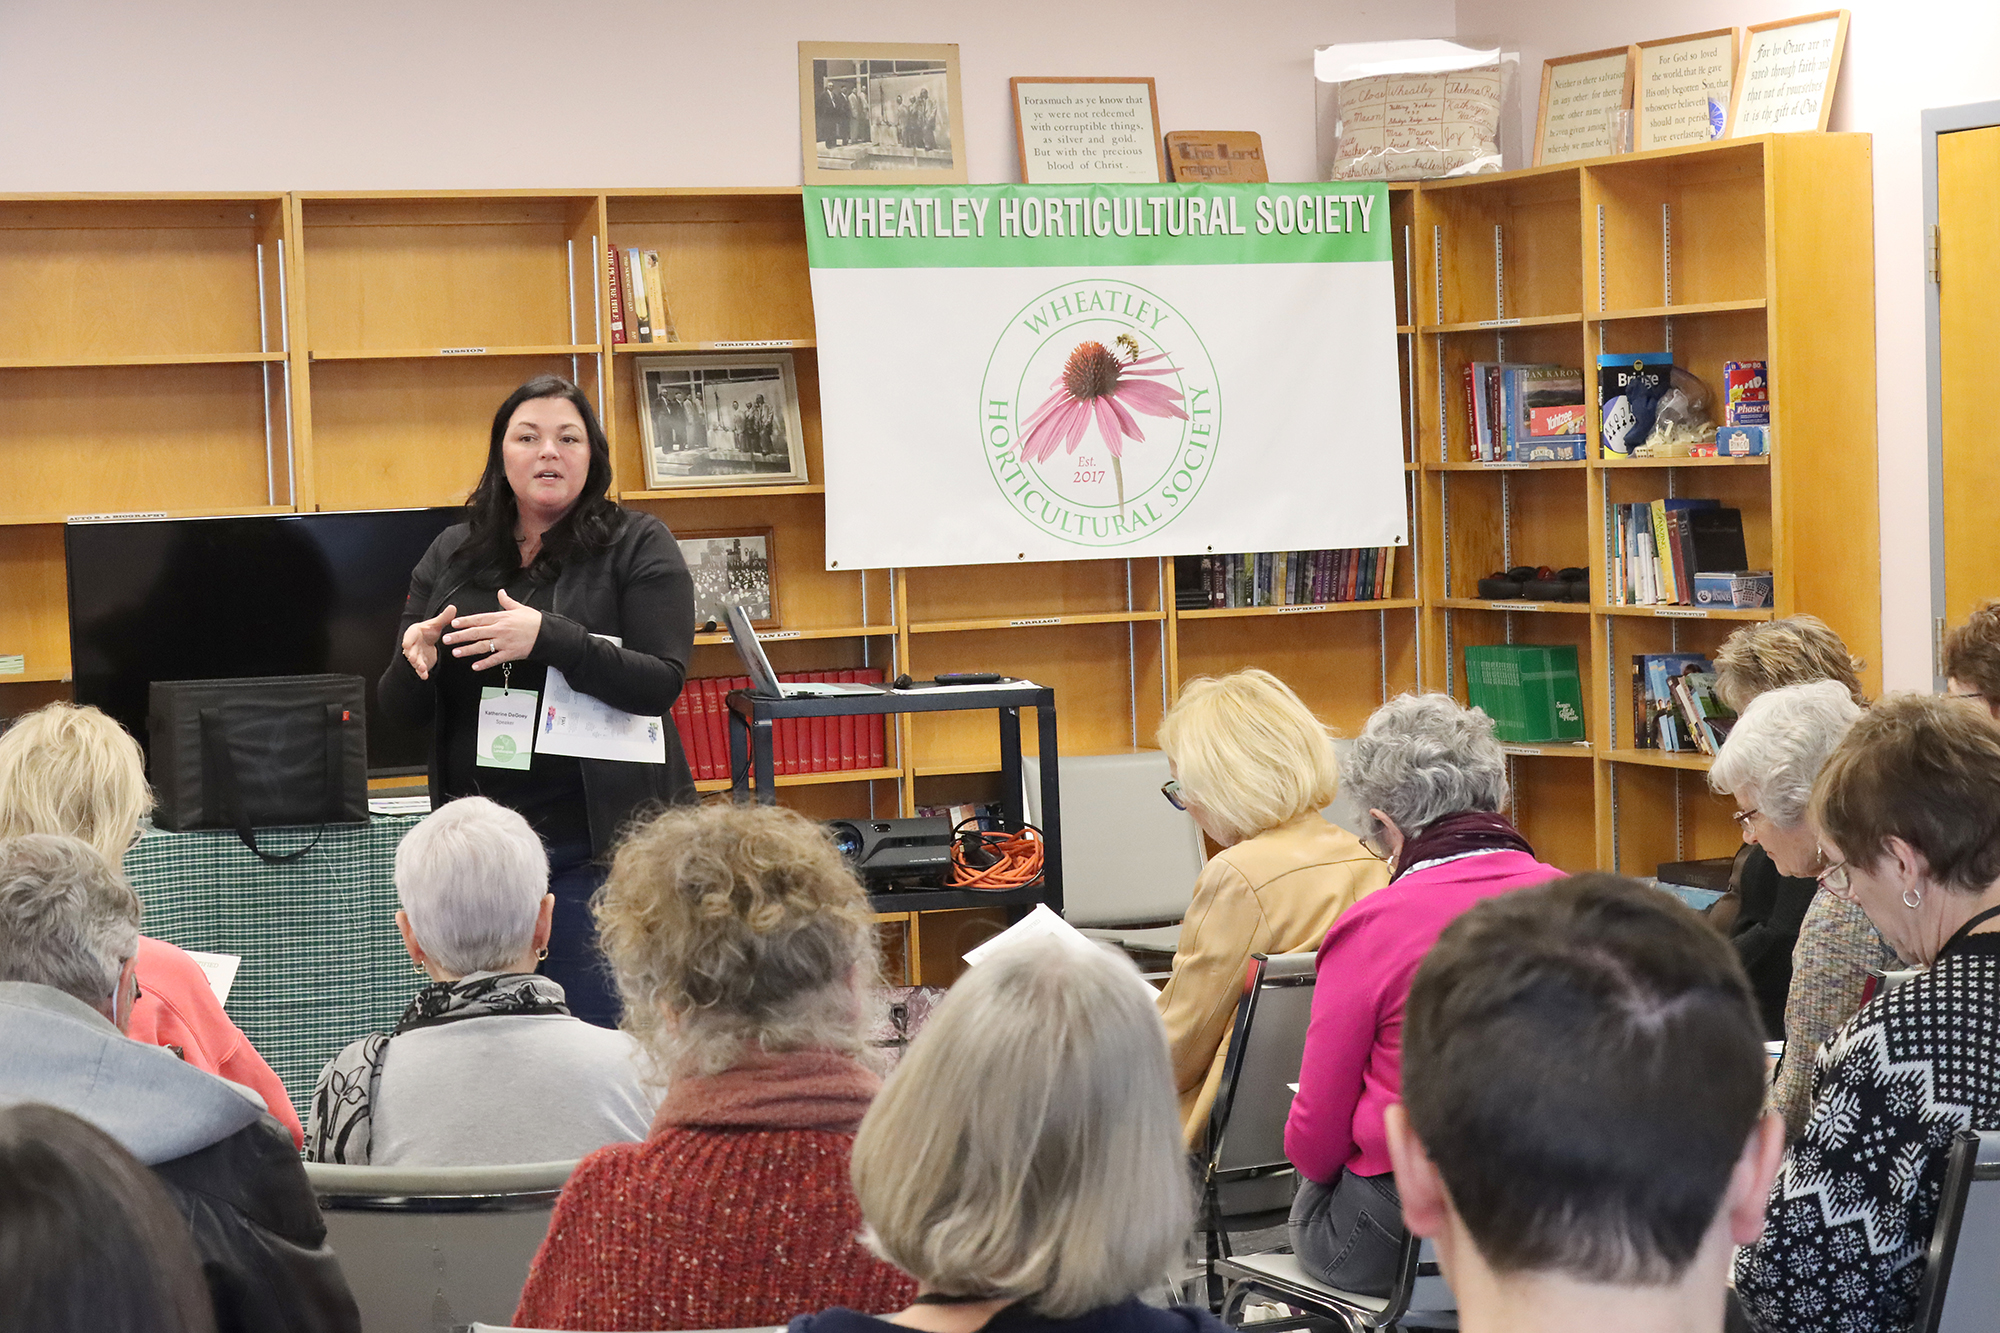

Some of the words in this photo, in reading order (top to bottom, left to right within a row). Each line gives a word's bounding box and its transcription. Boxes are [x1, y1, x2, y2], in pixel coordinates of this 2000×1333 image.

[1659, 56, 1670, 64] For
[1673, 52, 1687, 62] God
[1700, 48, 1717, 59] loved
[1753, 44, 1770, 63] For
[1652, 72, 1661, 81] the
[1663, 68, 1683, 79] world,
[1684, 67, 1696, 76] that
[1699, 66, 1705, 74] He
[1708, 65, 1721, 75] gave
[1771, 60, 1796, 80] through
[1446, 82, 1480, 95] Thelma
[1555, 80, 1576, 89] Neither
[1583, 76, 1597, 85] there
[1646, 88, 1656, 97] His
[1657, 86, 1670, 97] only
[1673, 85, 1699, 96] begotten
[1702, 79, 1715, 90] Son,
[1717, 79, 1728, 87] that
[1388, 83, 1436, 101] Wheatley
[1561, 98, 1570, 106] any
[1592, 90, 1601, 99] for
[1603, 89, 1617, 98] there
[1024, 96, 1072, 105] Forasmuch
[1086, 97, 1096, 107] ye
[1099, 96, 1123, 104] know
[1126, 96, 1143, 104] that
[1645, 103, 1676, 112] whosoever
[1678, 97, 1706, 108] believeth
[1034, 112, 1043, 121] ye
[1092, 109, 1135, 117] redeemed
[1568, 110, 1583, 119] other
[1586, 108, 1601, 116] name
[1771, 103, 1789, 126] gift
[1031, 123, 1051, 131] with
[1054, 122, 1106, 133] corruptible
[1650, 116, 1671, 127] should
[1675, 116, 1685, 124] not
[1444, 127, 1465, 146] Joy
[1549, 129, 1568, 137] heaven
[1569, 126, 1585, 138] given
[1588, 123, 1606, 133] among
[1653, 134, 1666, 142] have
[1670, 130, 1703, 140] everlasting
[1057, 135, 1083, 143] silver
[1088, 135, 1104, 143] and
[1548, 143, 1570, 153] whereby
[1596, 138, 1602, 146] be
[1034, 148, 1050, 156] But
[1056, 148, 1077, 156] with
[1082, 148, 1097, 156] the
[1102, 147, 1142, 158] precious
[1047, 161, 1074, 170] blood
[1080, 161, 1090, 169] of
[821, 197, 990, 238] WHEATLEY
[999, 196, 1246, 238] HORTICULTURAL
[1255, 194, 1375, 235] SOCIETY
[1023, 289, 1169, 335] WHEATLEY
[1547, 369, 1580, 377] KARON
[1736, 404, 1760, 414] Phase
[1546, 410, 1573, 431] Yahtzee
[988, 399, 1163, 538] HORTICULTURAL
[1161, 386, 1212, 508] SOCIETY
[1078, 456, 1097, 467] Est.
[1073, 470, 1106, 485] 2017
